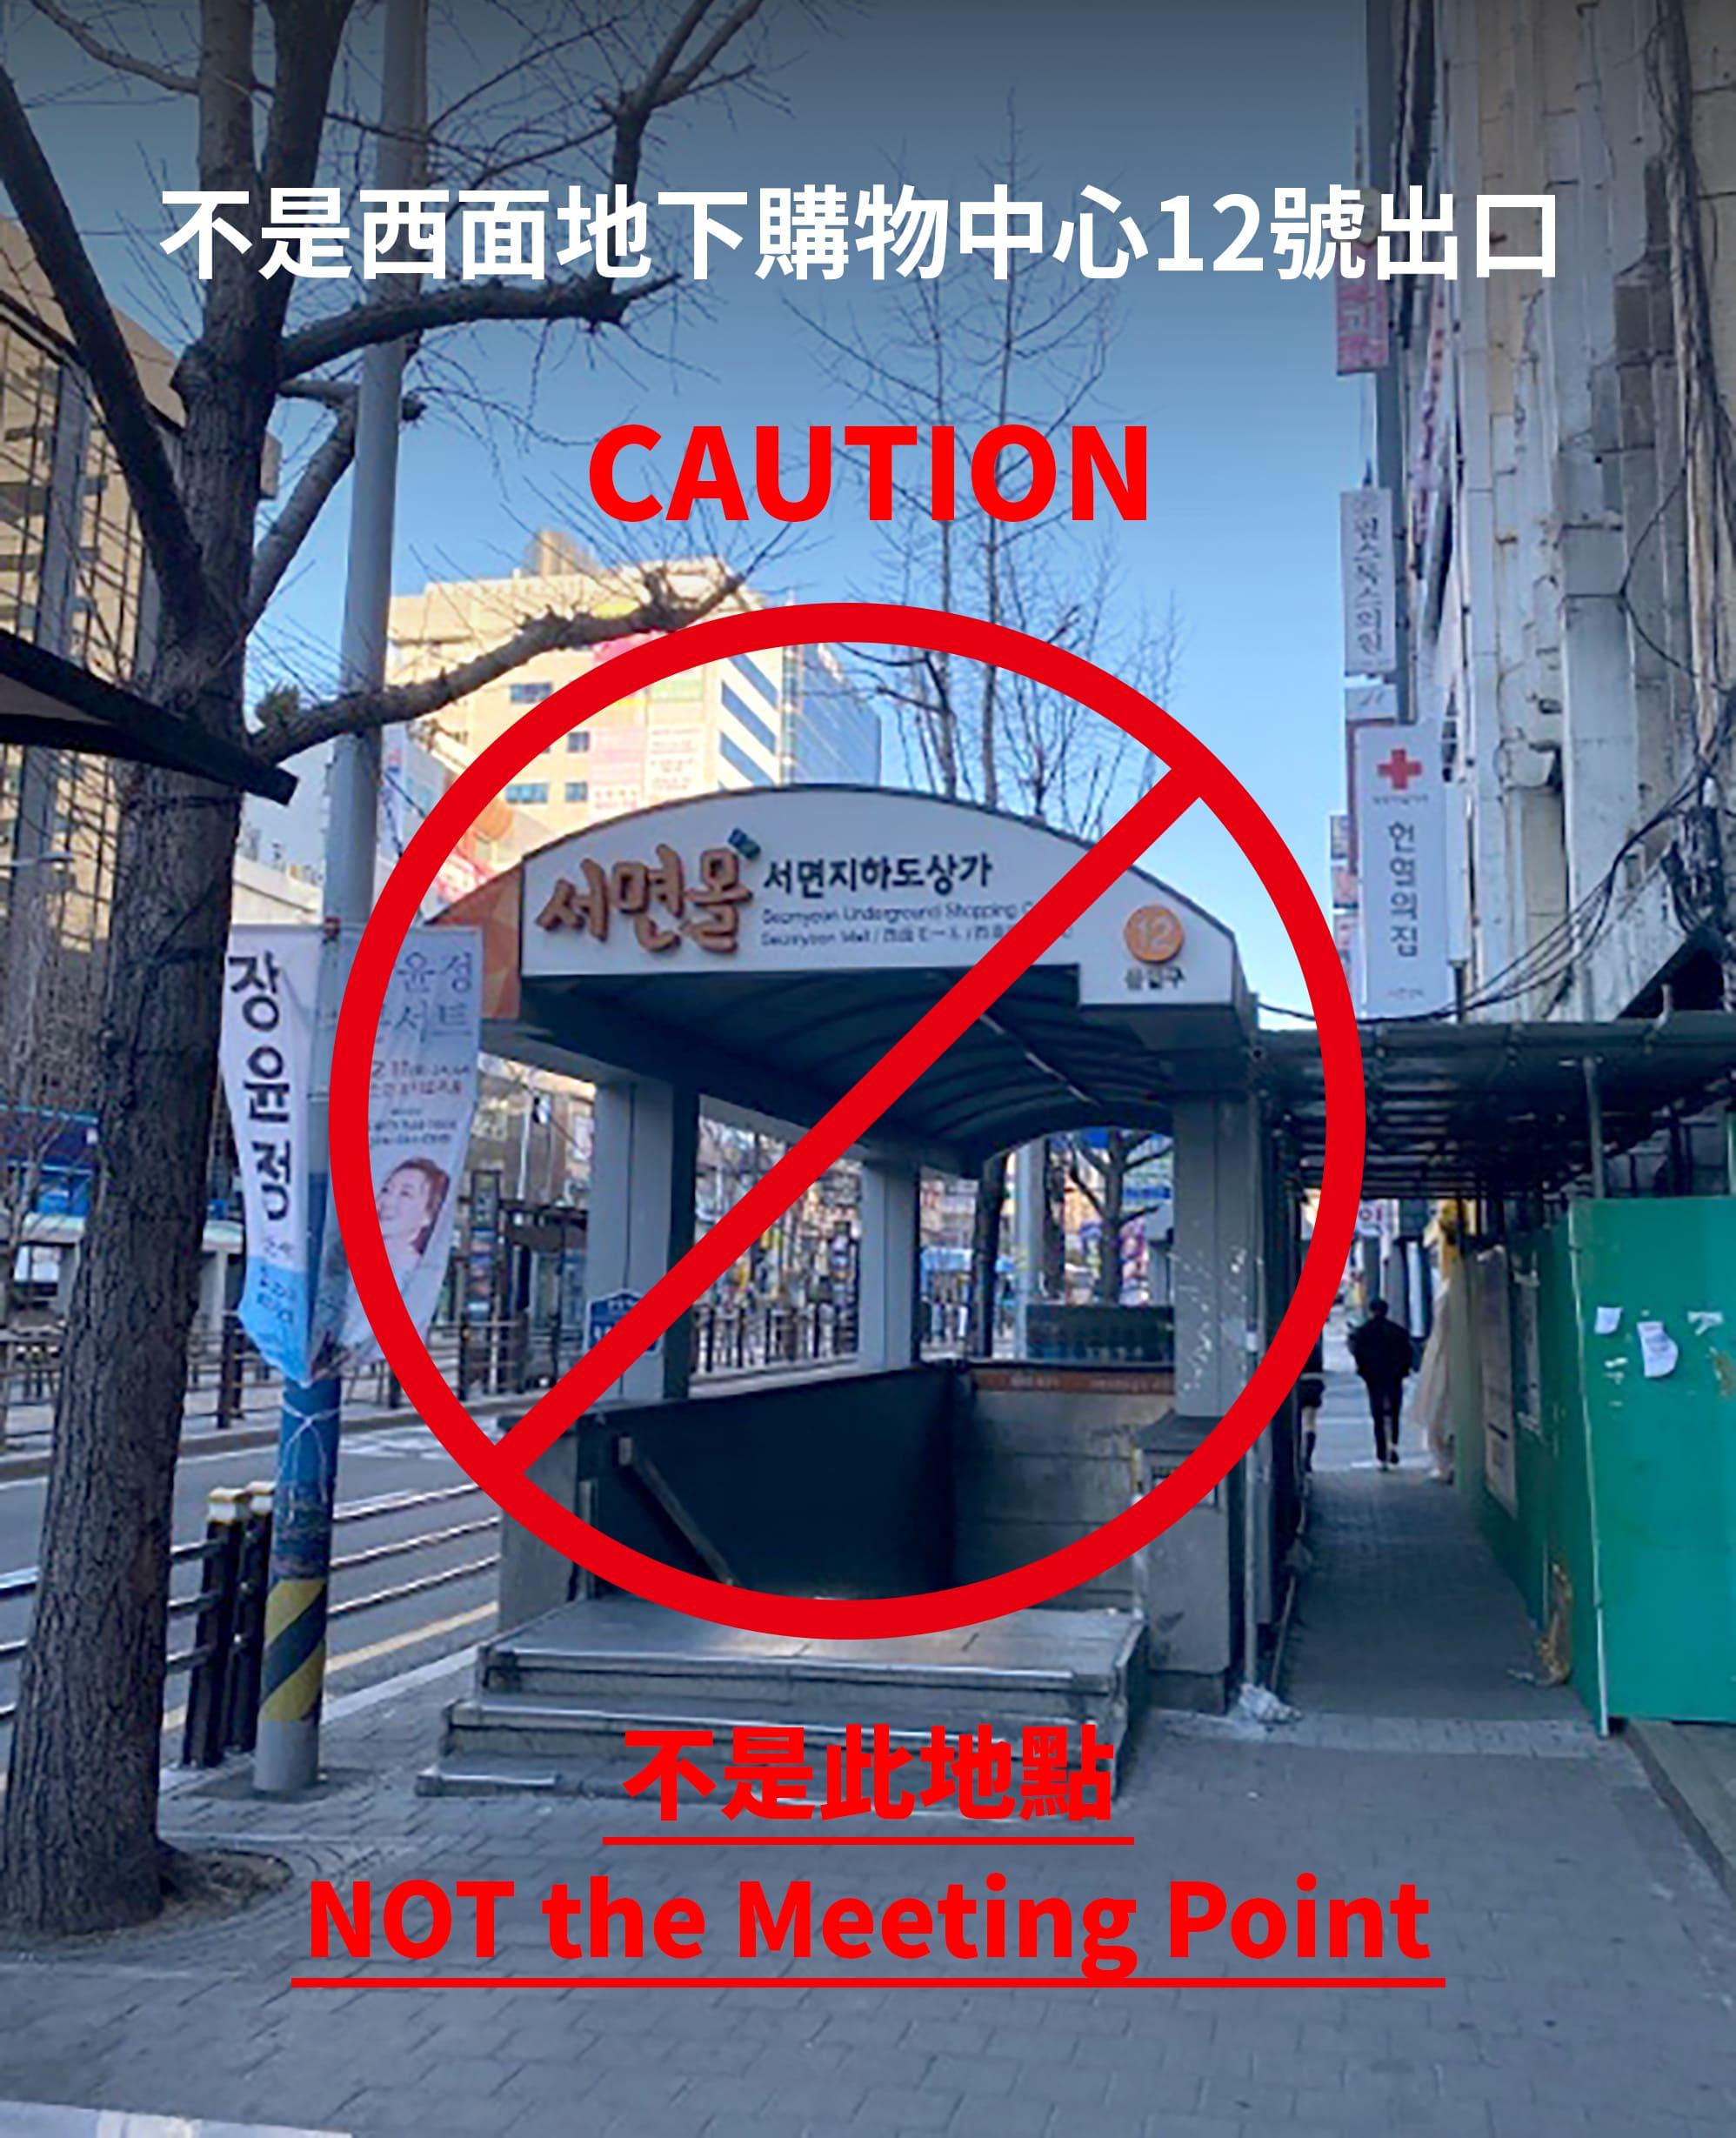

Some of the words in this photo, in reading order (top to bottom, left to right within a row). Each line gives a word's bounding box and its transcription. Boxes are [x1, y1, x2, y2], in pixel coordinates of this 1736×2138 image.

[764, 852, 993, 899] 서면지하도상가
[536, 843, 753, 954] 서면몰
[944, 901, 1017, 922] Shopping
[1136, 916, 1175, 952] 12
[397, 951, 473, 993] 윤정
[228, 951, 290, 1220] 장윤정
